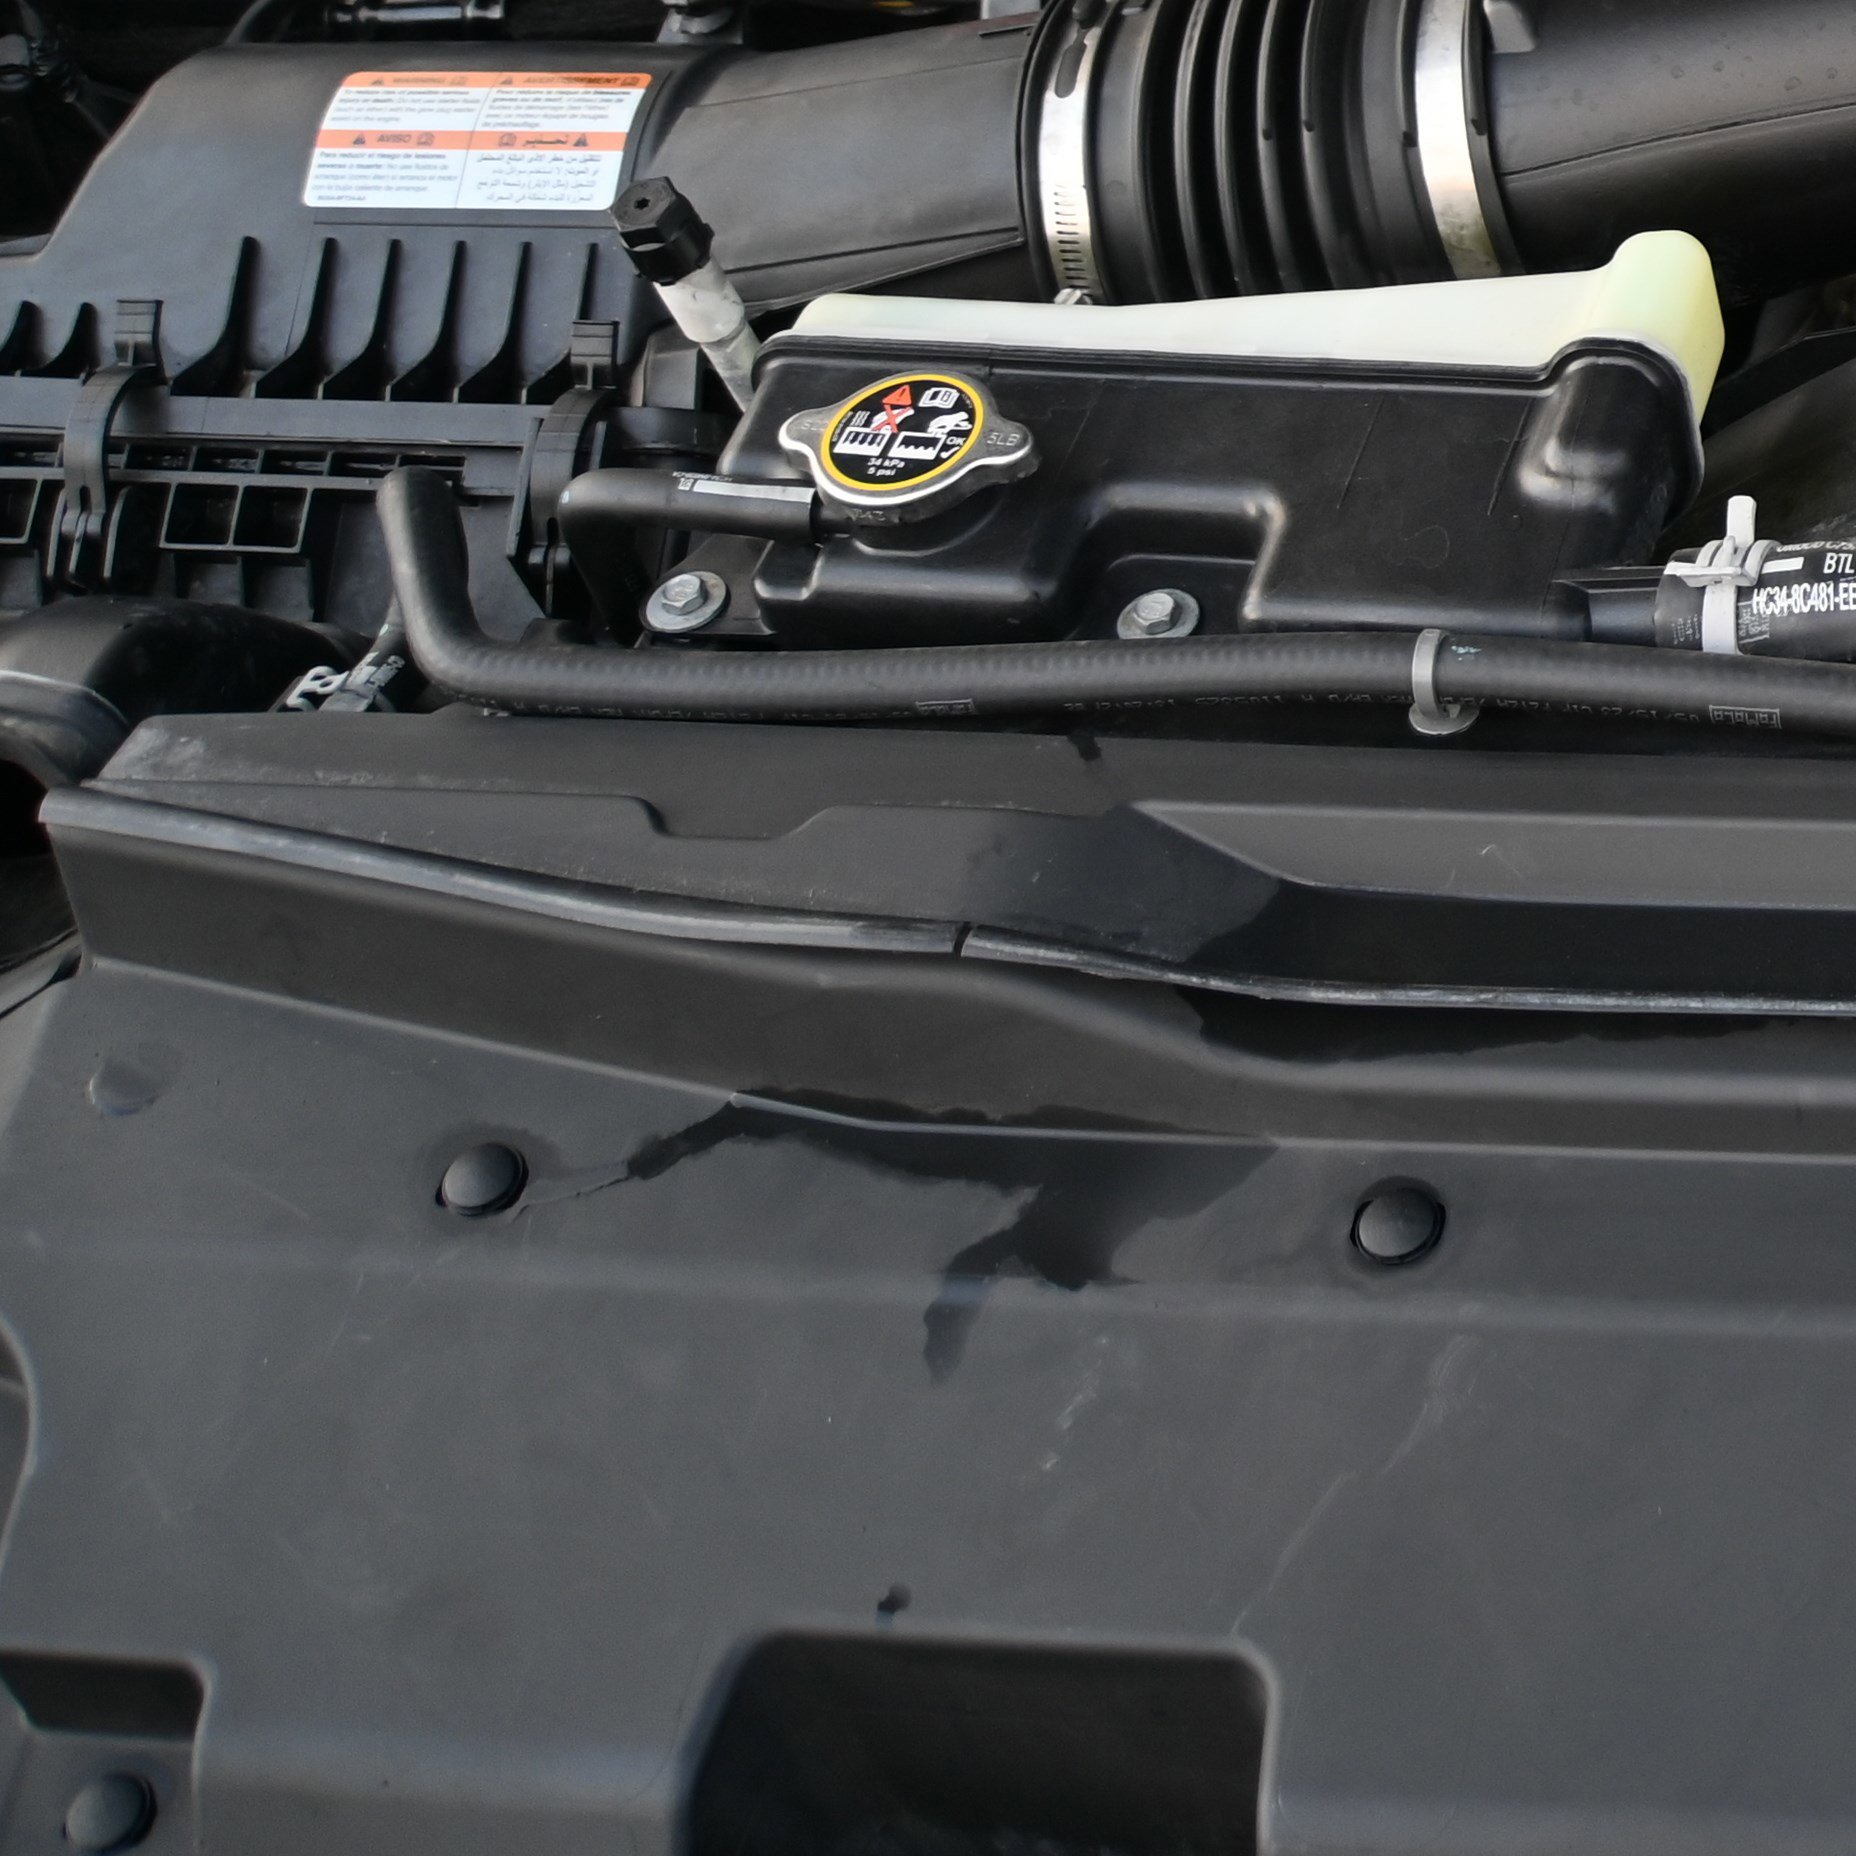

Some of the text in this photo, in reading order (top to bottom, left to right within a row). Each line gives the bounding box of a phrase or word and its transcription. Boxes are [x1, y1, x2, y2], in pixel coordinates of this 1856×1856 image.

[946, 436, 966, 445] OK
[883, 458, 905, 468] kPa
[876, 468, 896, 476] psi
[1823, 553, 1855, 574] BTL
